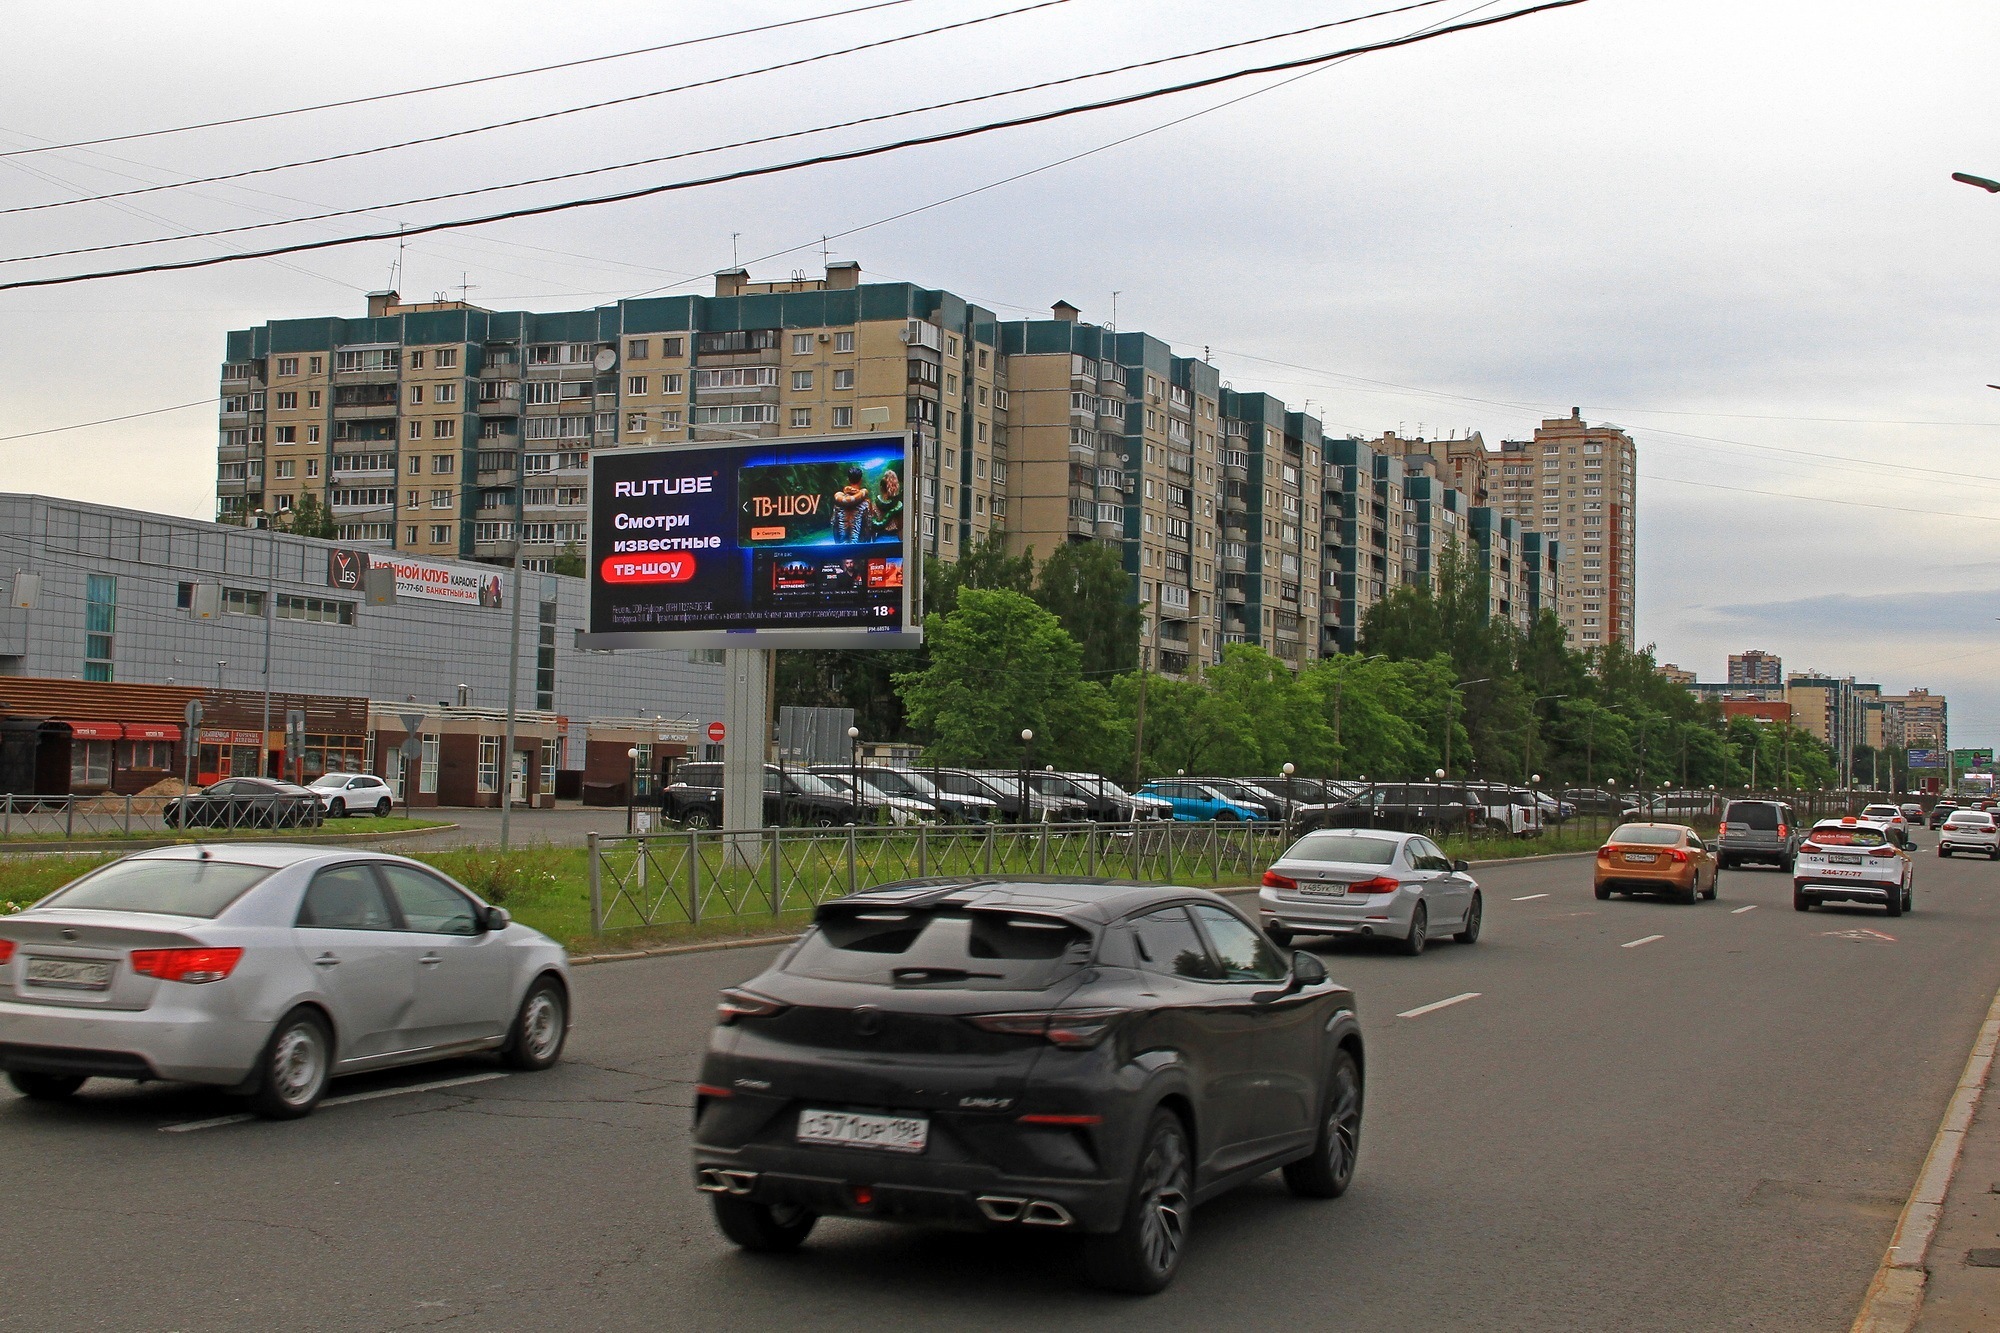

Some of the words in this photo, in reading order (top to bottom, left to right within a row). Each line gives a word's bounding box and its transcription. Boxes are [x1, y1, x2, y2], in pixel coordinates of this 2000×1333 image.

[615, 476, 713, 498] RUTUBE
[752, 494, 821, 517] ТВ-ШОУ
[614, 513, 690, 531] Смотри
[614, 536, 721, 552] известные
[337, 553, 356, 583] YES
[614, 561, 682, 578] тв-шоу
[421, 568, 449, 584] КЛУБ
[451, 575, 477, 588] КАРАОКЕ
[426, 586, 463, 598] БАНКЕТНЫЙ
[465, 591, 477, 599] ЗАЛ
[873, 606, 895, 617] 18+
[1821, 869, 1862, 877] 244-77-77
